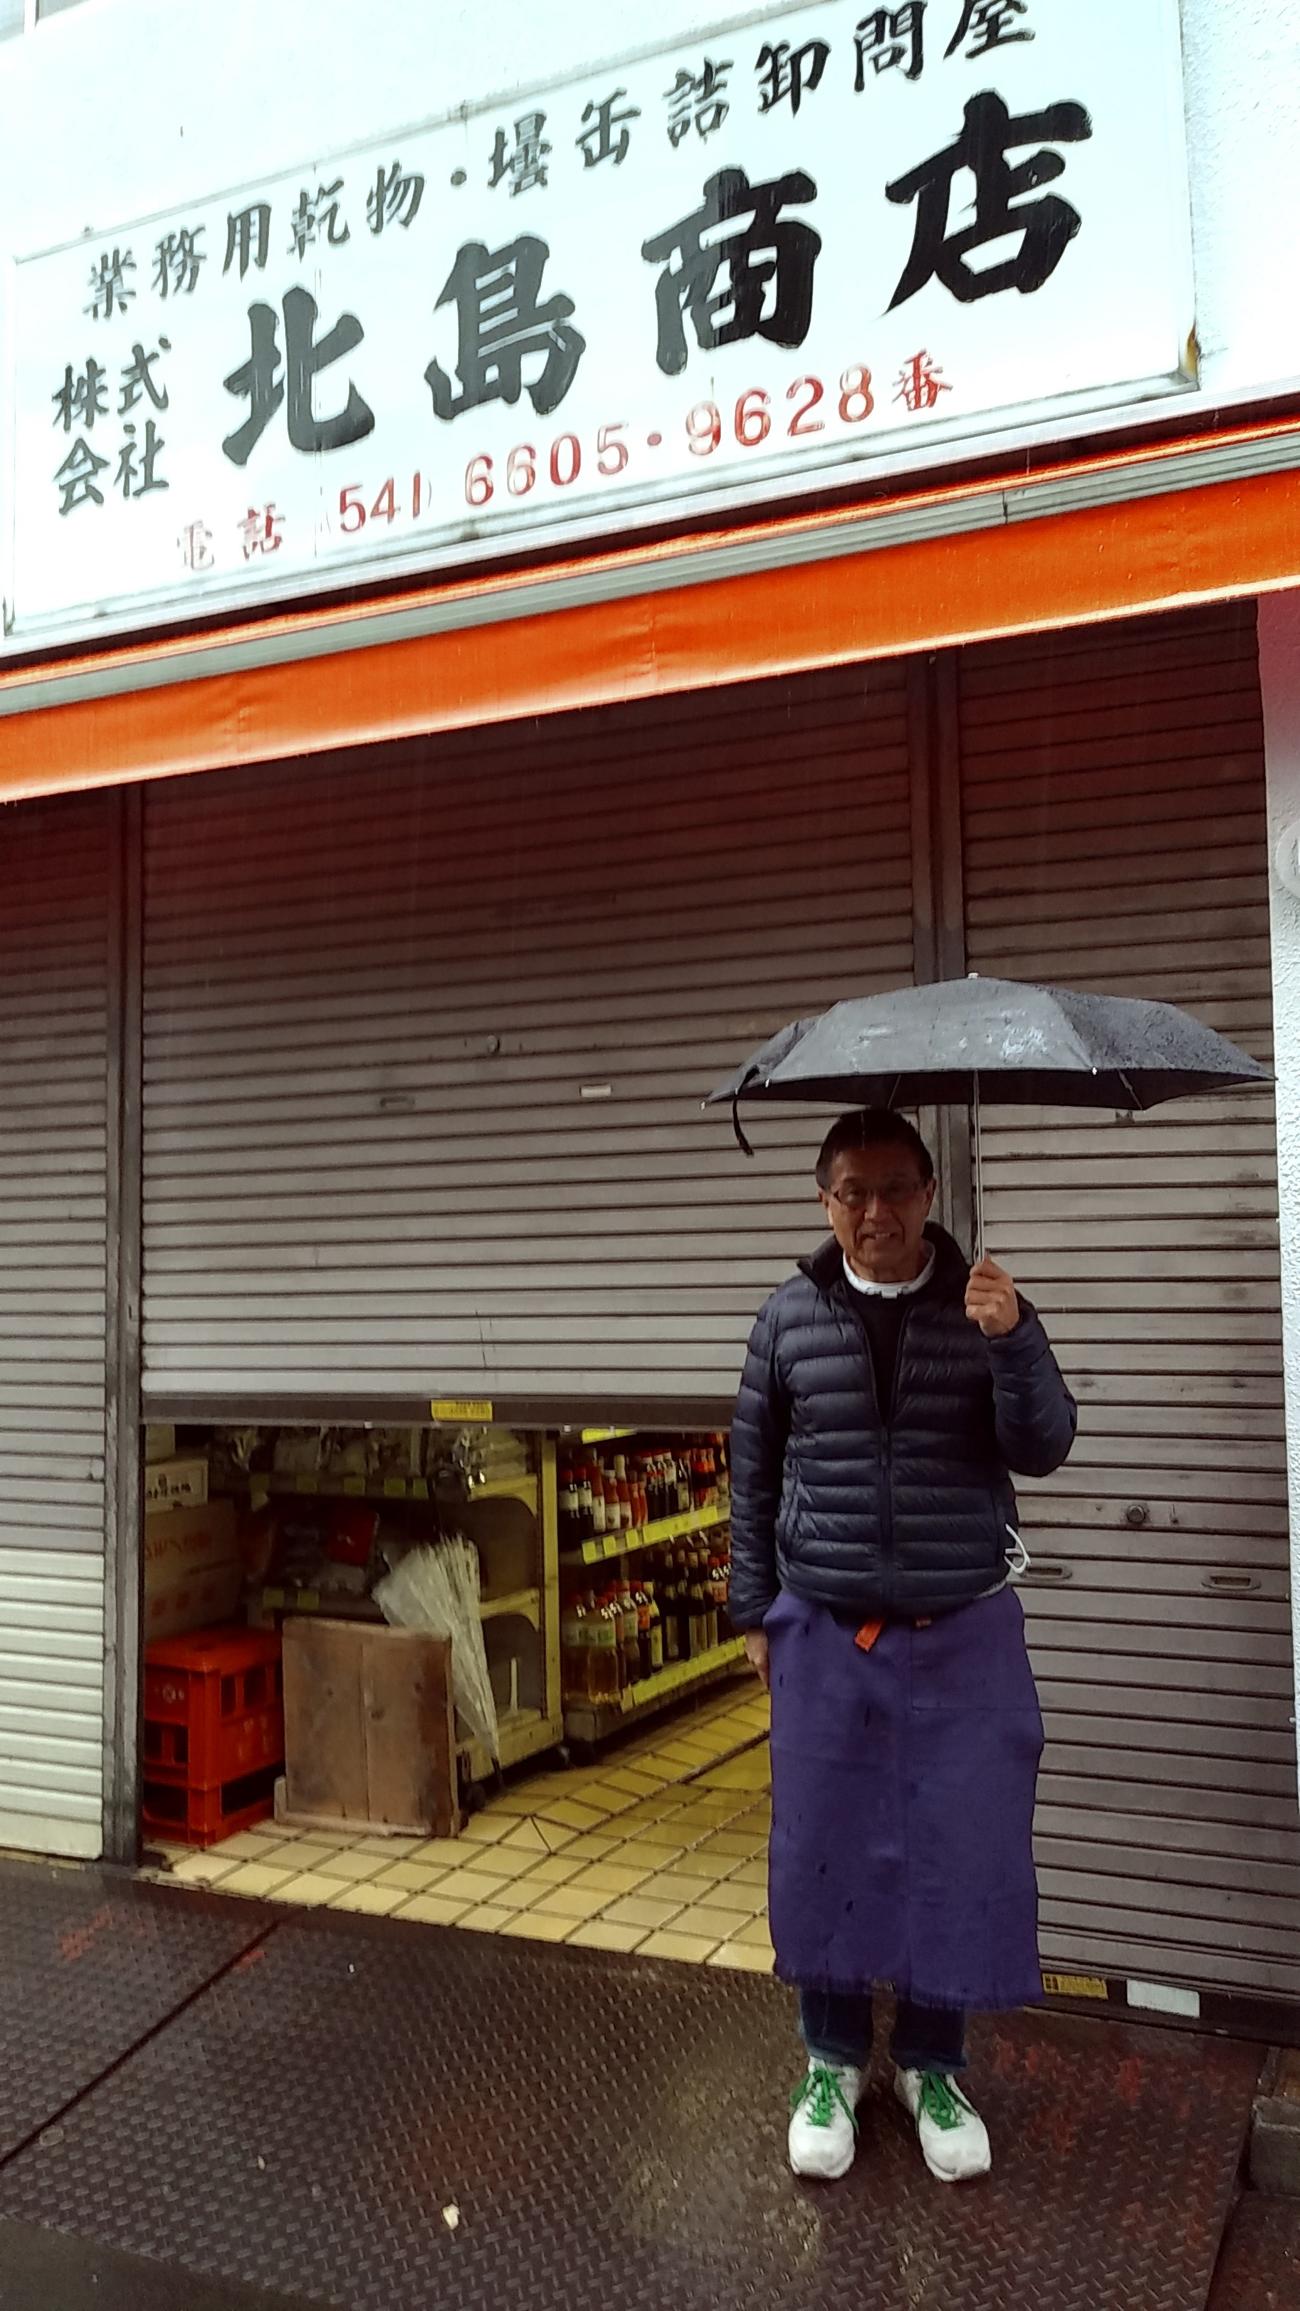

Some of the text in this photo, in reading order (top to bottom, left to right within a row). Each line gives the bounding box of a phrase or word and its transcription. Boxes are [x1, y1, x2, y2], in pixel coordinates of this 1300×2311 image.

[222, 88, 1092, 466] 北島商店
[52, 334, 171, 431] 株式
[53, 420, 169, 514] 会社
